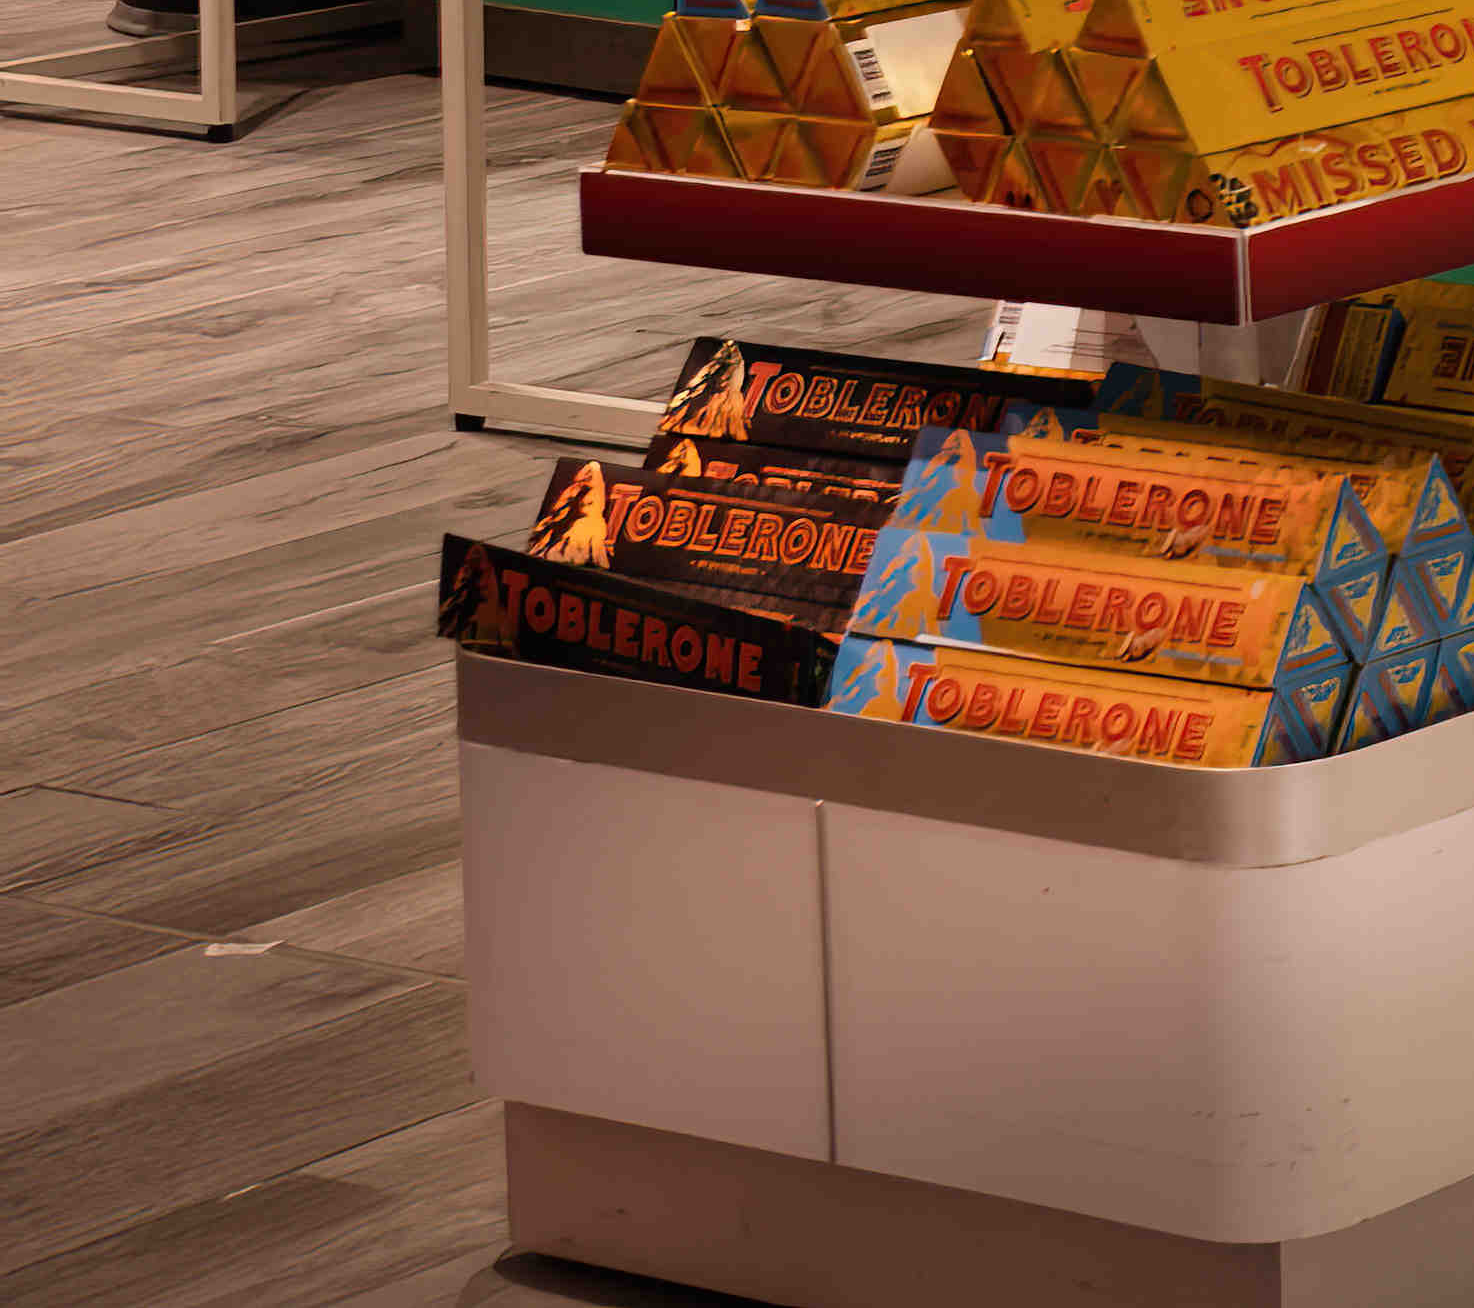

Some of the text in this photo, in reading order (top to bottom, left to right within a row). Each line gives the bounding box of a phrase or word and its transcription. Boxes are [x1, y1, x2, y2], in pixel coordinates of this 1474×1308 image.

[1251, 127, 1468, 221] MISSED
[980, 451, 1289, 545] TOBLERONE
[501, 570, 763, 692] TOBLERONE
[936, 554, 1245, 648] TOBLERONE
[901, 662, 1215, 760] TOBLERONE
